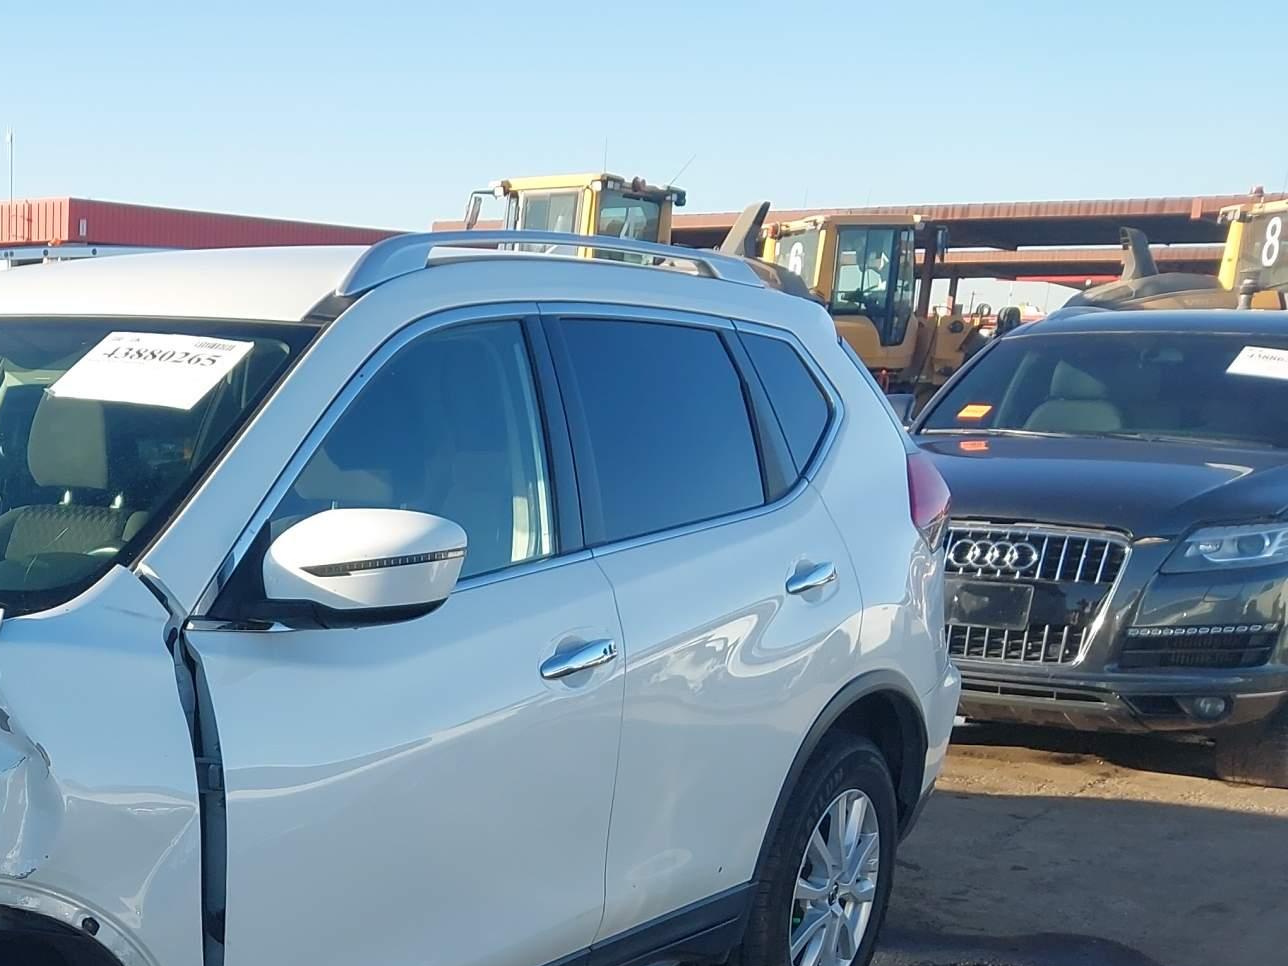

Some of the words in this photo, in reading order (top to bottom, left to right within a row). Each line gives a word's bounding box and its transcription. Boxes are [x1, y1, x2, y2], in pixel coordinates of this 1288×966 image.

[788, 241, 803, 276] 6
[1261, 216, 1282, 267] 8
[103, 346, 222, 367] 43880265
